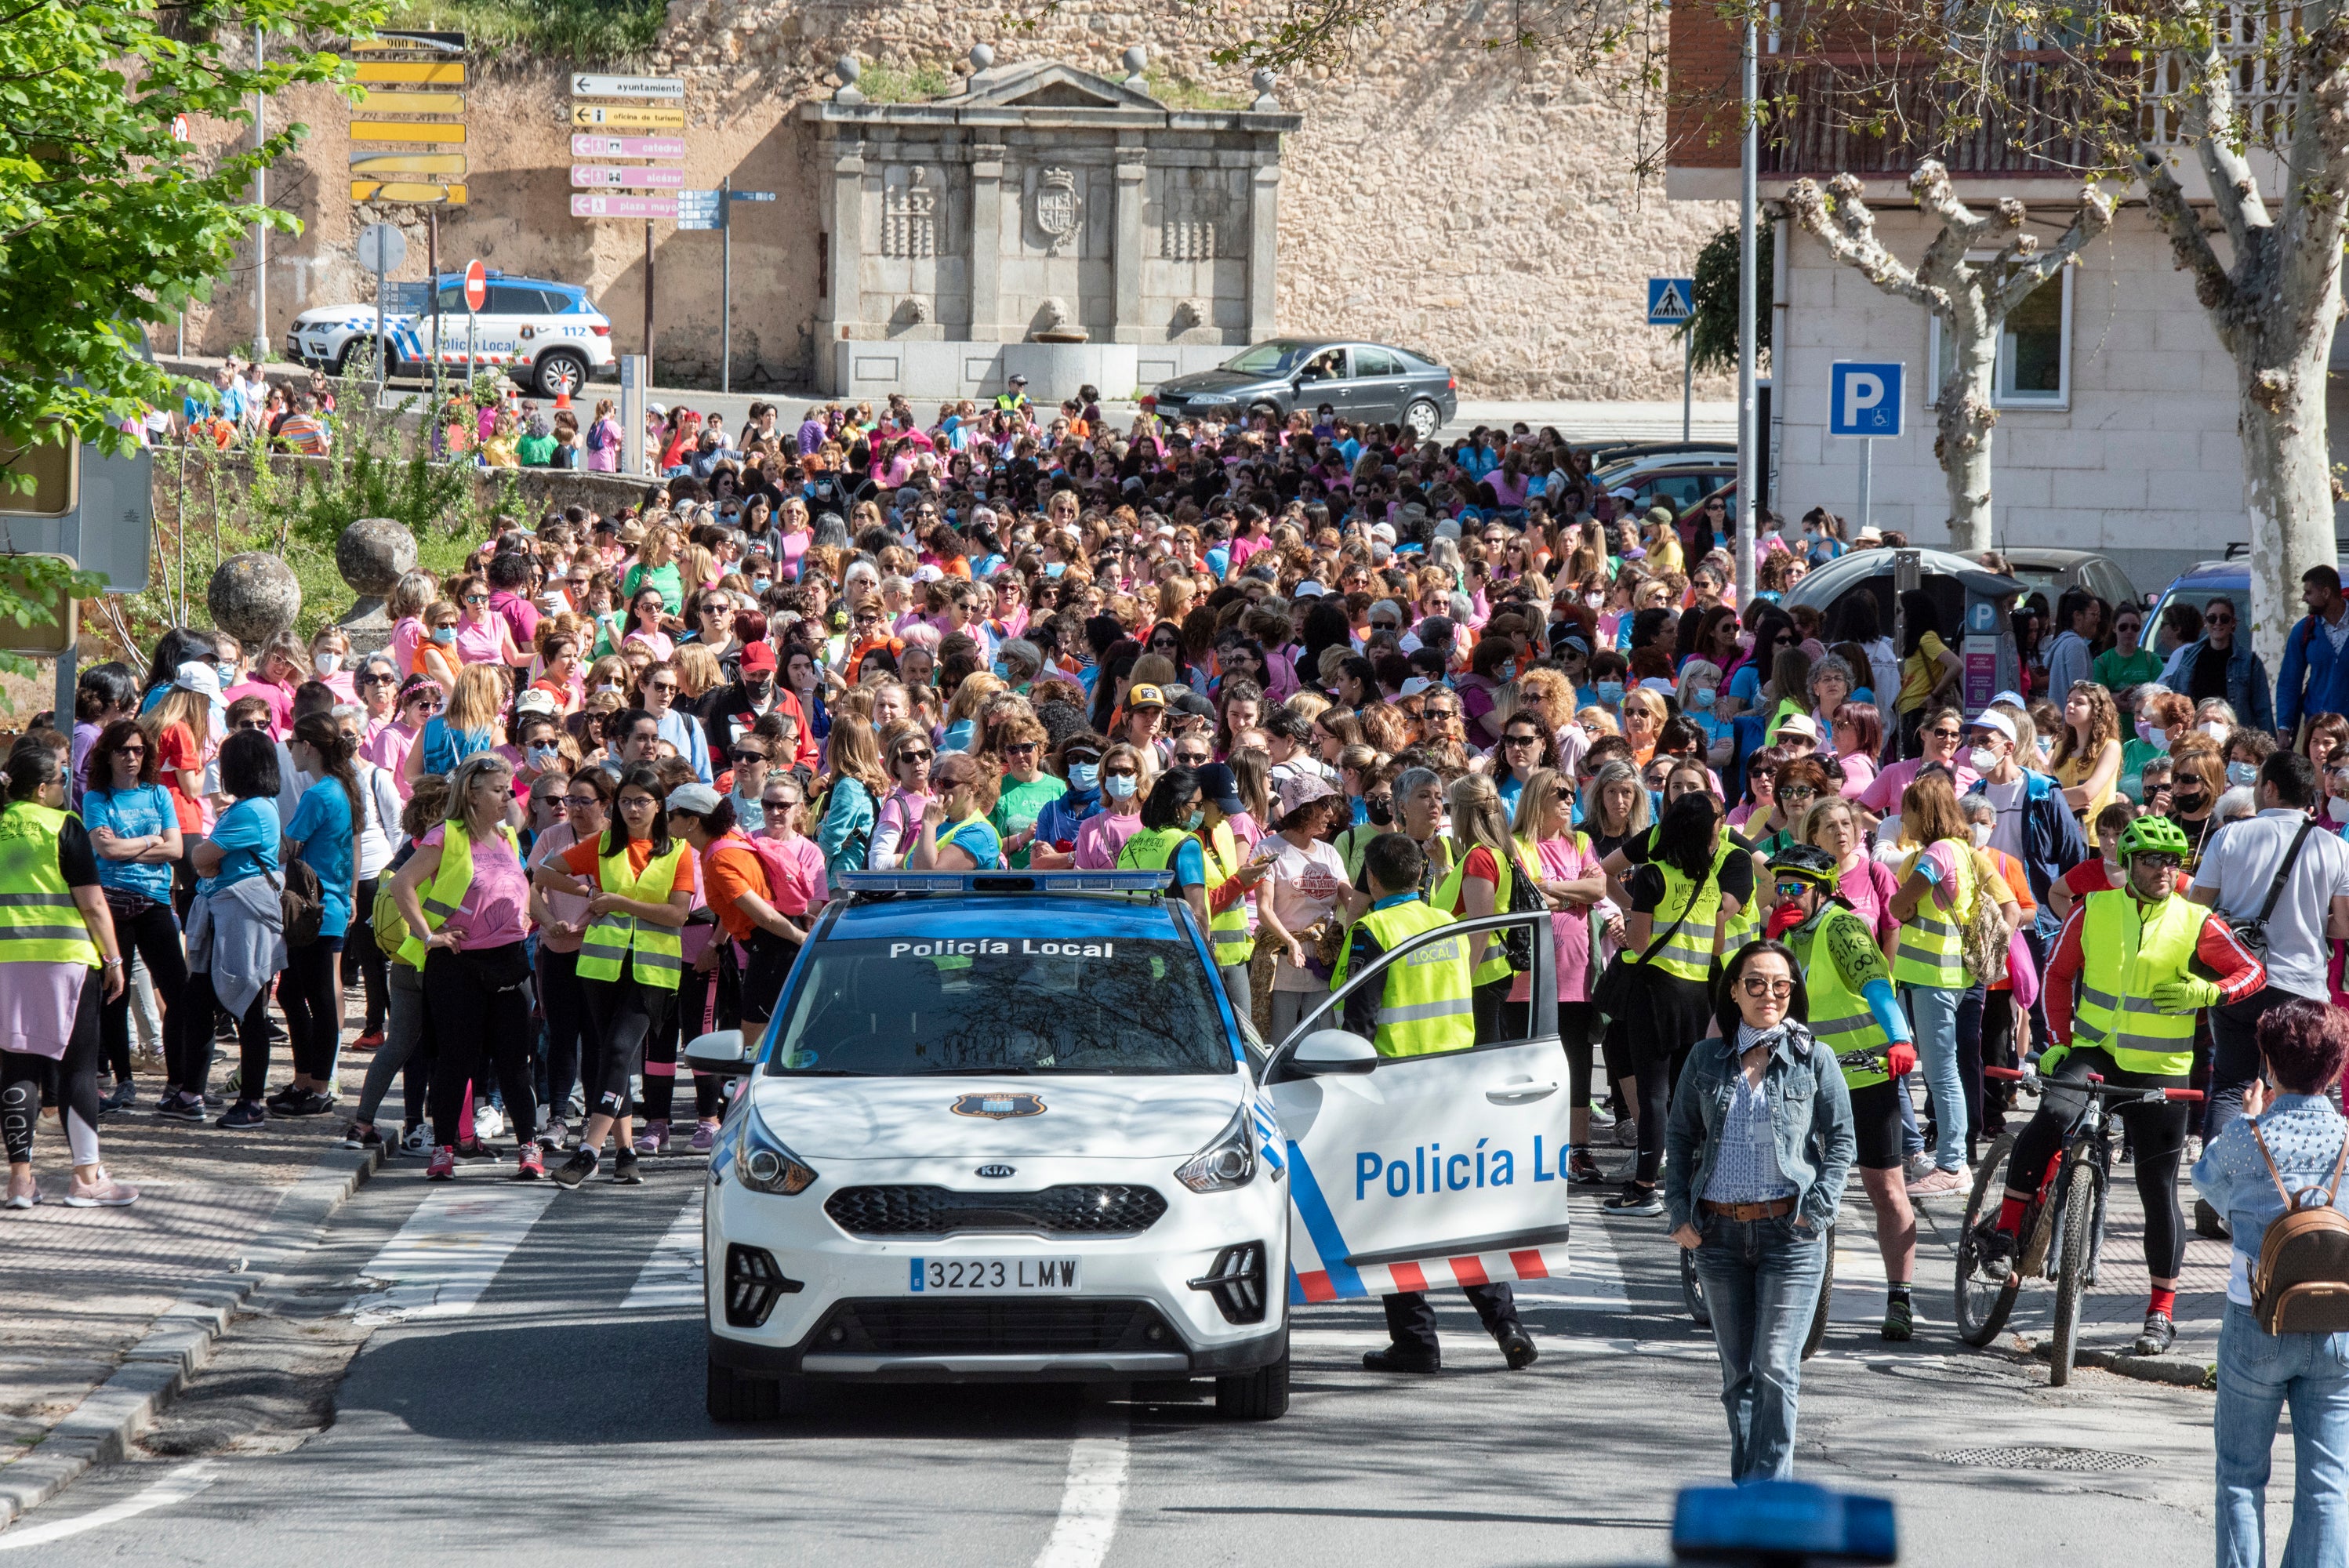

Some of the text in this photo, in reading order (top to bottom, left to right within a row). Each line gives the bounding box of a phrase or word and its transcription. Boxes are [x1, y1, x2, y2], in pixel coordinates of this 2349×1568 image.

[617, 82, 682, 93] ayuntamiento
[642, 143, 681, 154] catedral
[620, 201, 680, 214] plaza mayo
[562, 326, 586, 337] 112
[482, 339, 515, 352] Local
[1843, 372, 1886, 427] P
[1976, 604, 1993, 630] P
[890, 939, 1113, 958] Policía Local
[1414, 947, 1453, 964] LOCAL
[982, 1166, 1011, 1175] KIA
[1356, 1138, 1514, 1201] Policía
[929, 1261, 1006, 1288] 3223
[1018, 1261, 1076, 1287] LMW
